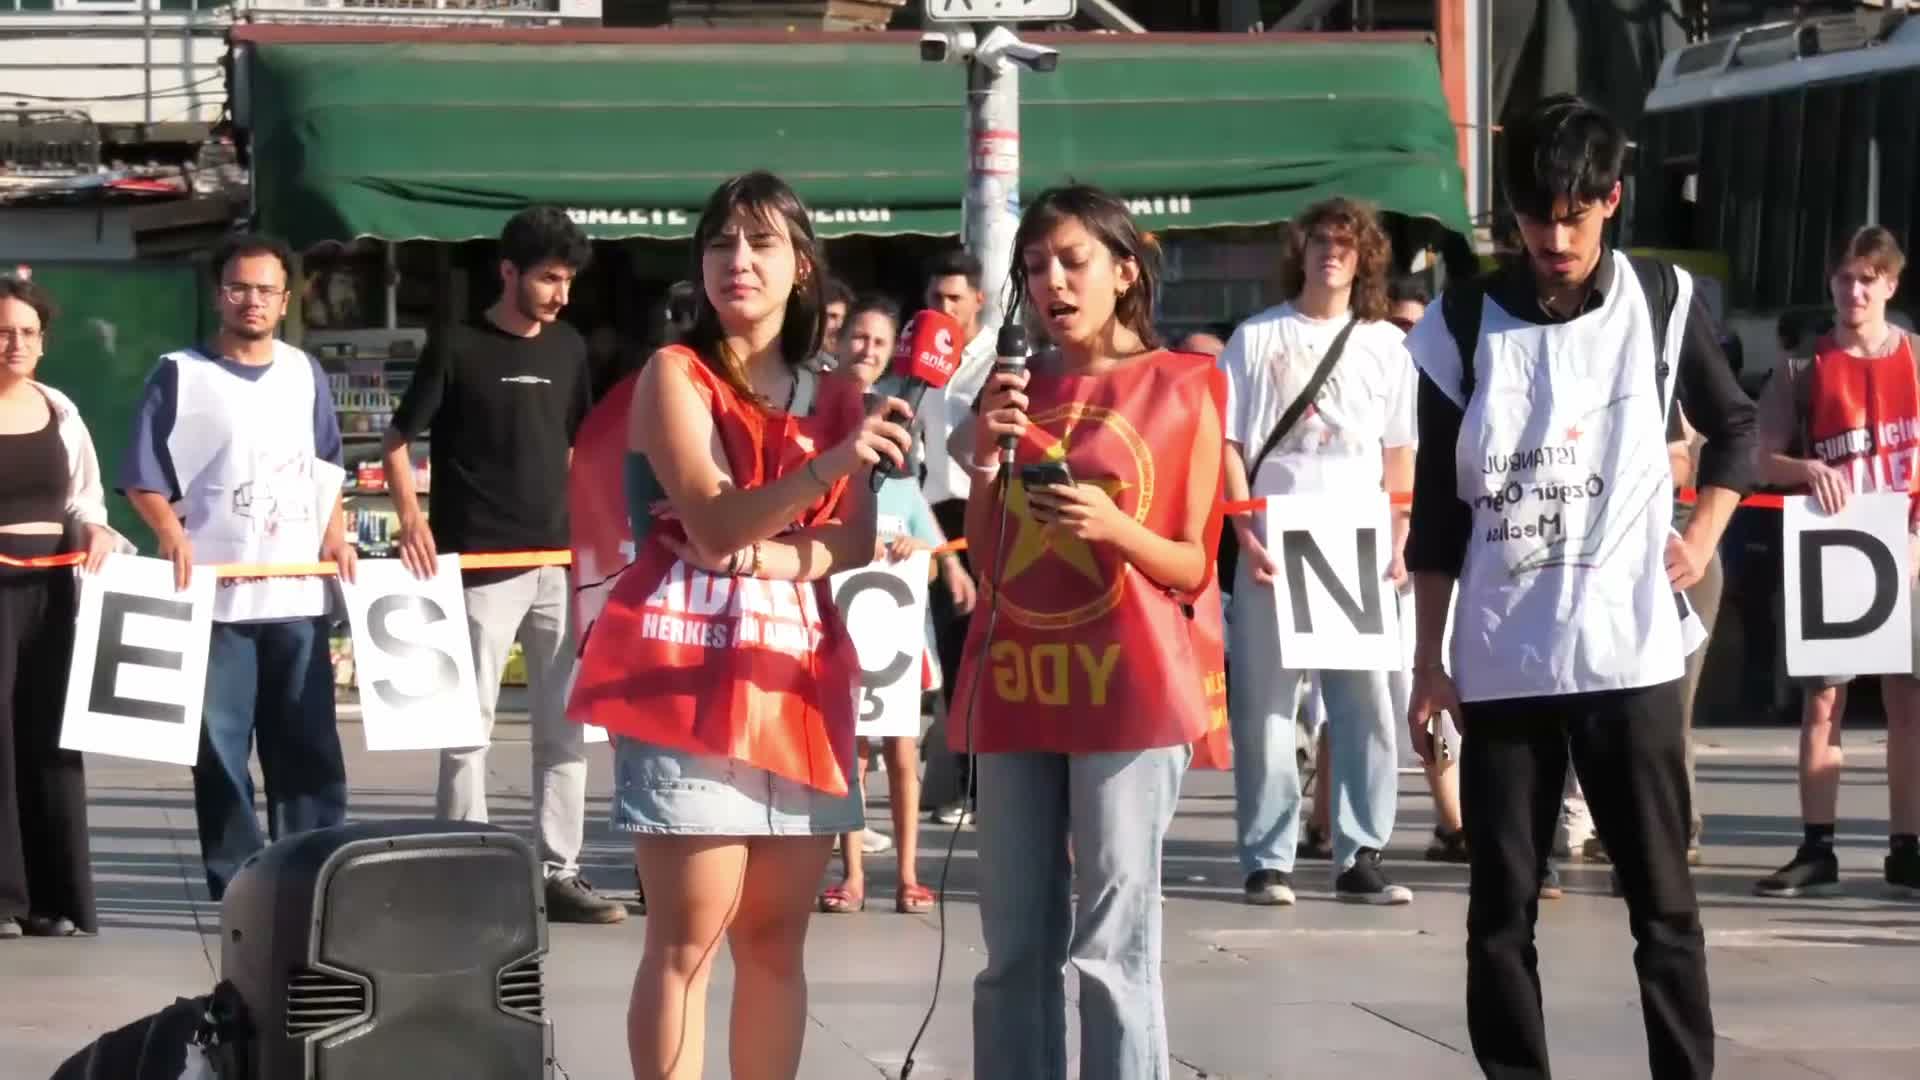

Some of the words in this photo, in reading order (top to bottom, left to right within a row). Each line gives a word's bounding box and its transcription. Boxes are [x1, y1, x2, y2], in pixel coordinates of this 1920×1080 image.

[642, 613, 728, 648] HERKES
[1282, 528, 1385, 635] N
[1799, 529, 1900, 641] D
[88, 591, 193, 725] E
[366, 594, 460, 708] S
